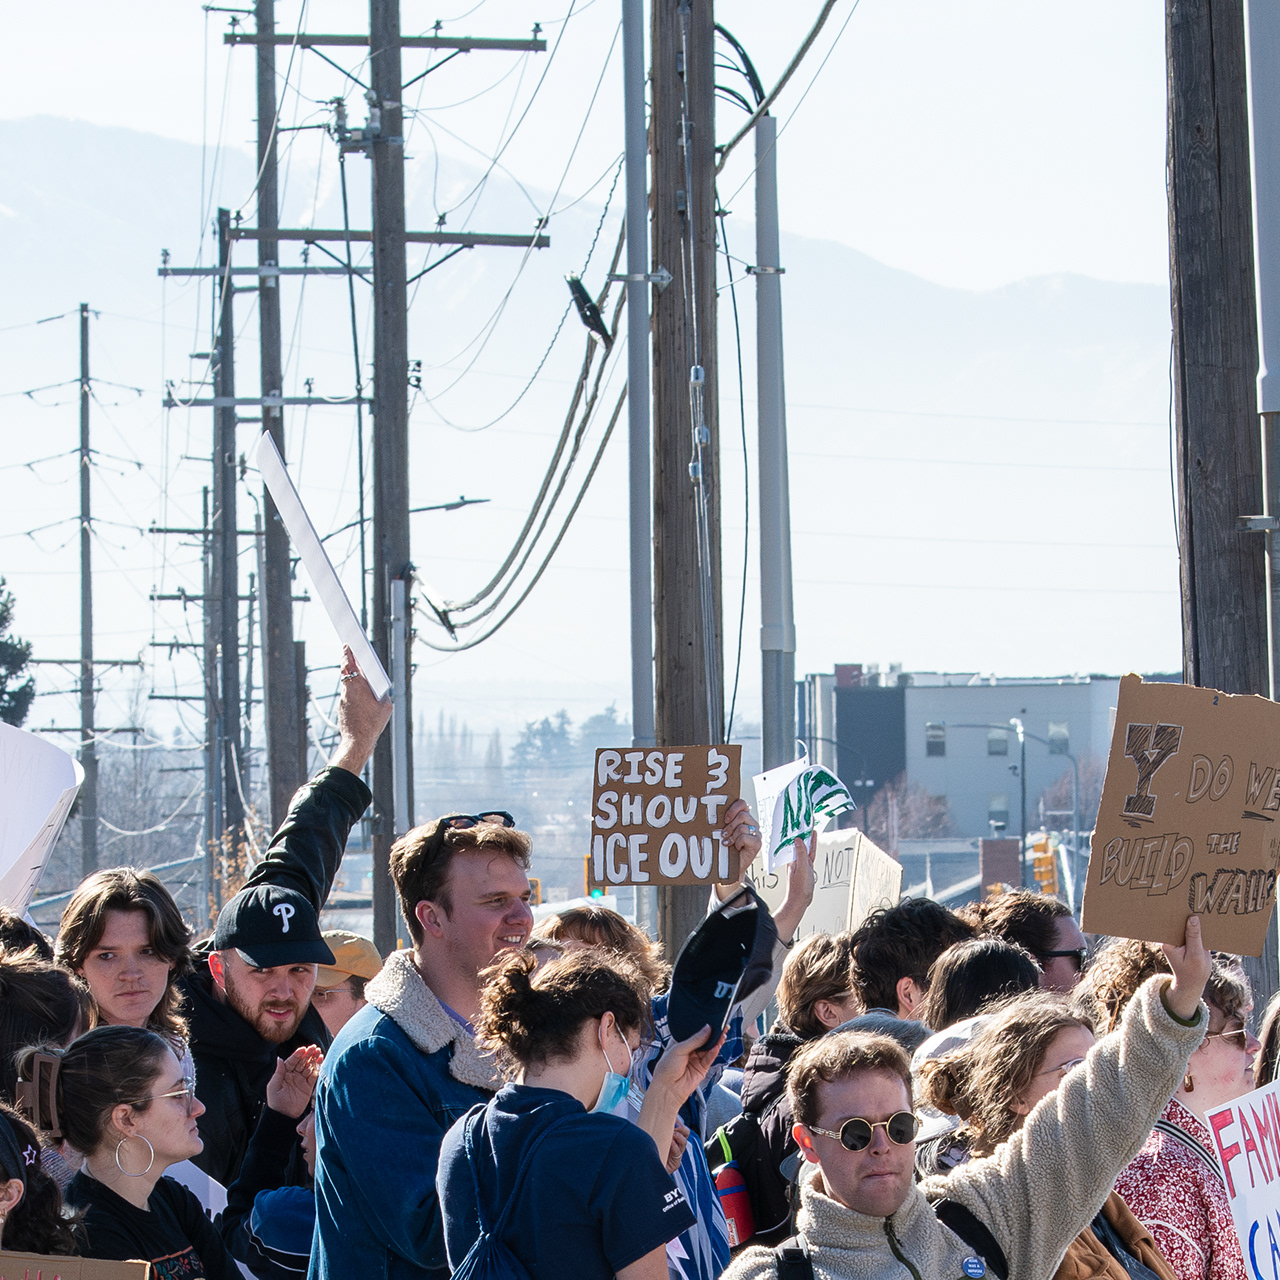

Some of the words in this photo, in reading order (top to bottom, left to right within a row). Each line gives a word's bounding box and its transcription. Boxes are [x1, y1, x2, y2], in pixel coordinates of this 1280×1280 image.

[597, 750, 684, 788] RISE
[1125, 722, 1184, 817] Y
[1186, 754, 1234, 803] DO
[593, 790, 727, 830] SHOUT
[593, 832, 650, 884] ICE
[658, 831, 730, 881] OUT
[823, 847, 854, 886] NOT
[1100, 833, 1194, 896] BUILD
[1207, 832, 1241, 854] THE
[272, 902, 295, 933] P
